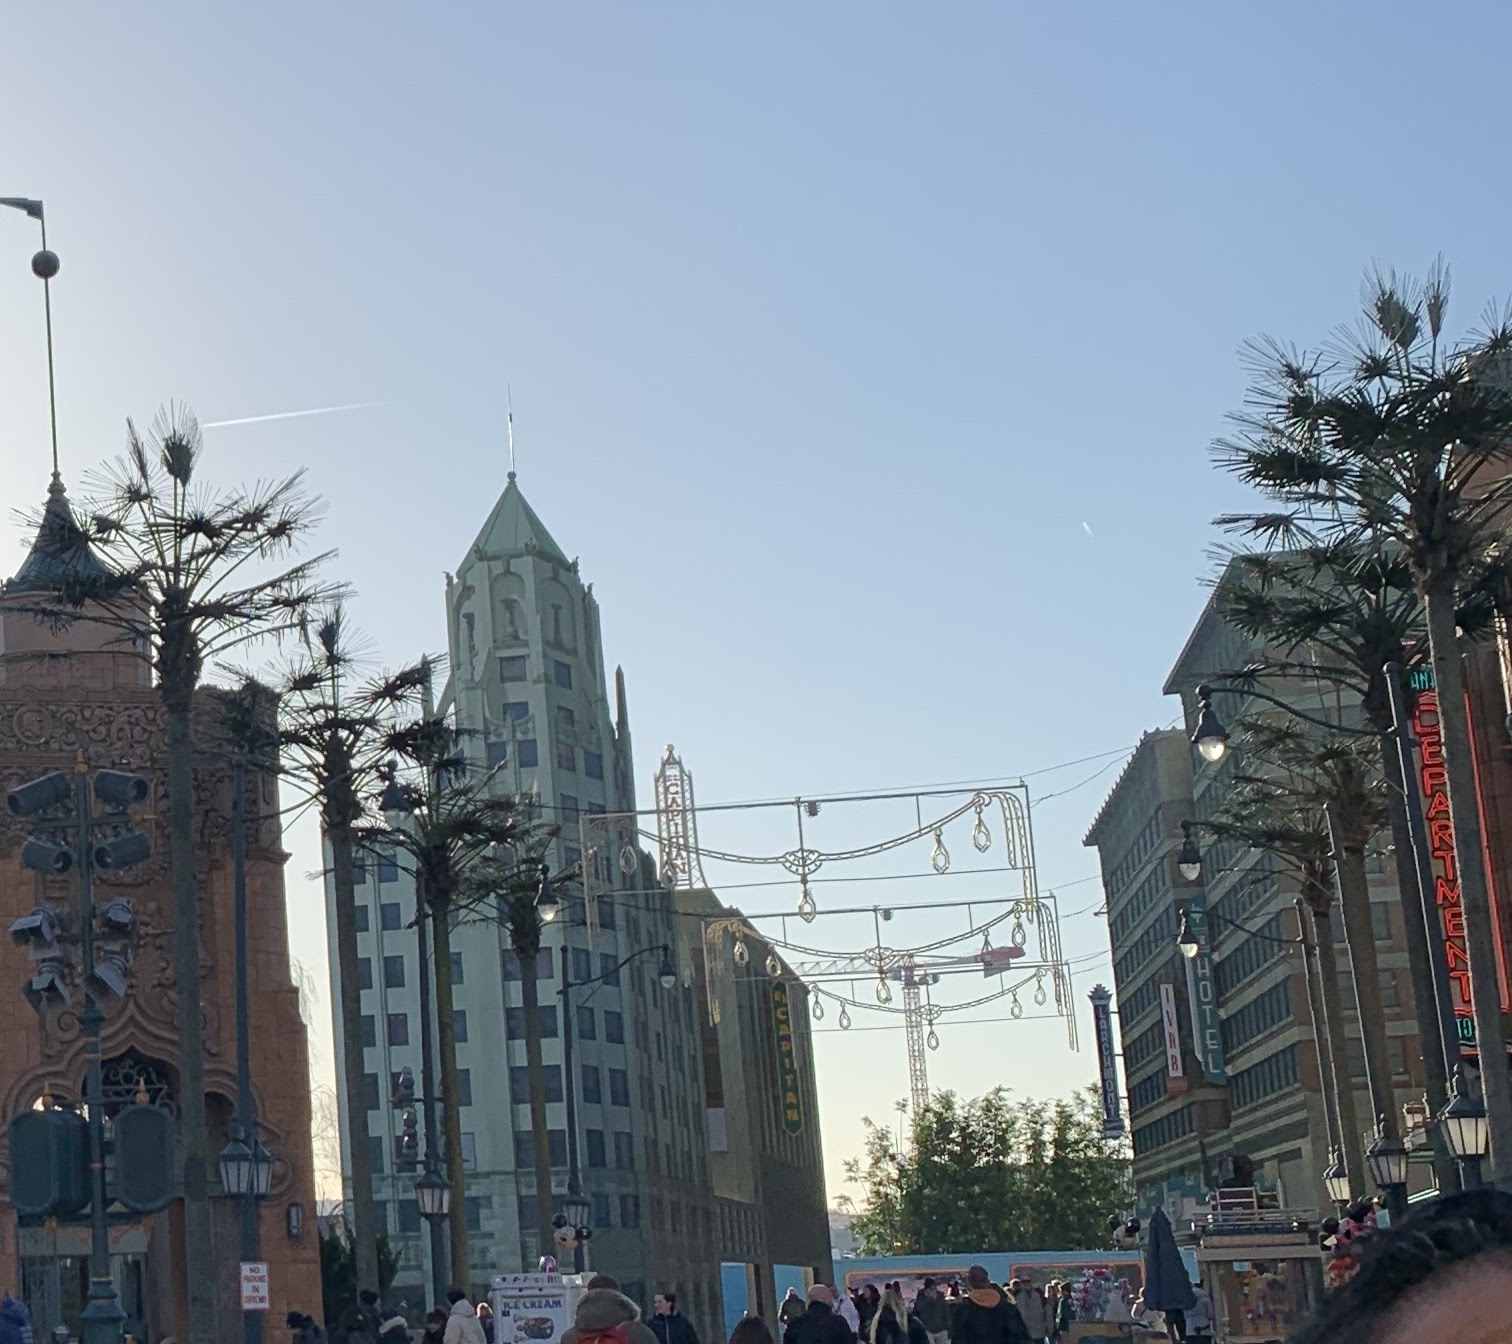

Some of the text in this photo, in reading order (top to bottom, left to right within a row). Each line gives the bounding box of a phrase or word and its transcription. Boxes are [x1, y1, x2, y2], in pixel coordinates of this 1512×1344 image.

[667, 782, 688, 875] CAPITAN
[1197, 957, 1221, 1073] HOTEL
[776, 1006, 799, 1121] CAPITAN
[249, 1266, 260, 1274] NO
[503, 1299, 562, 1310] ICE CREAM
